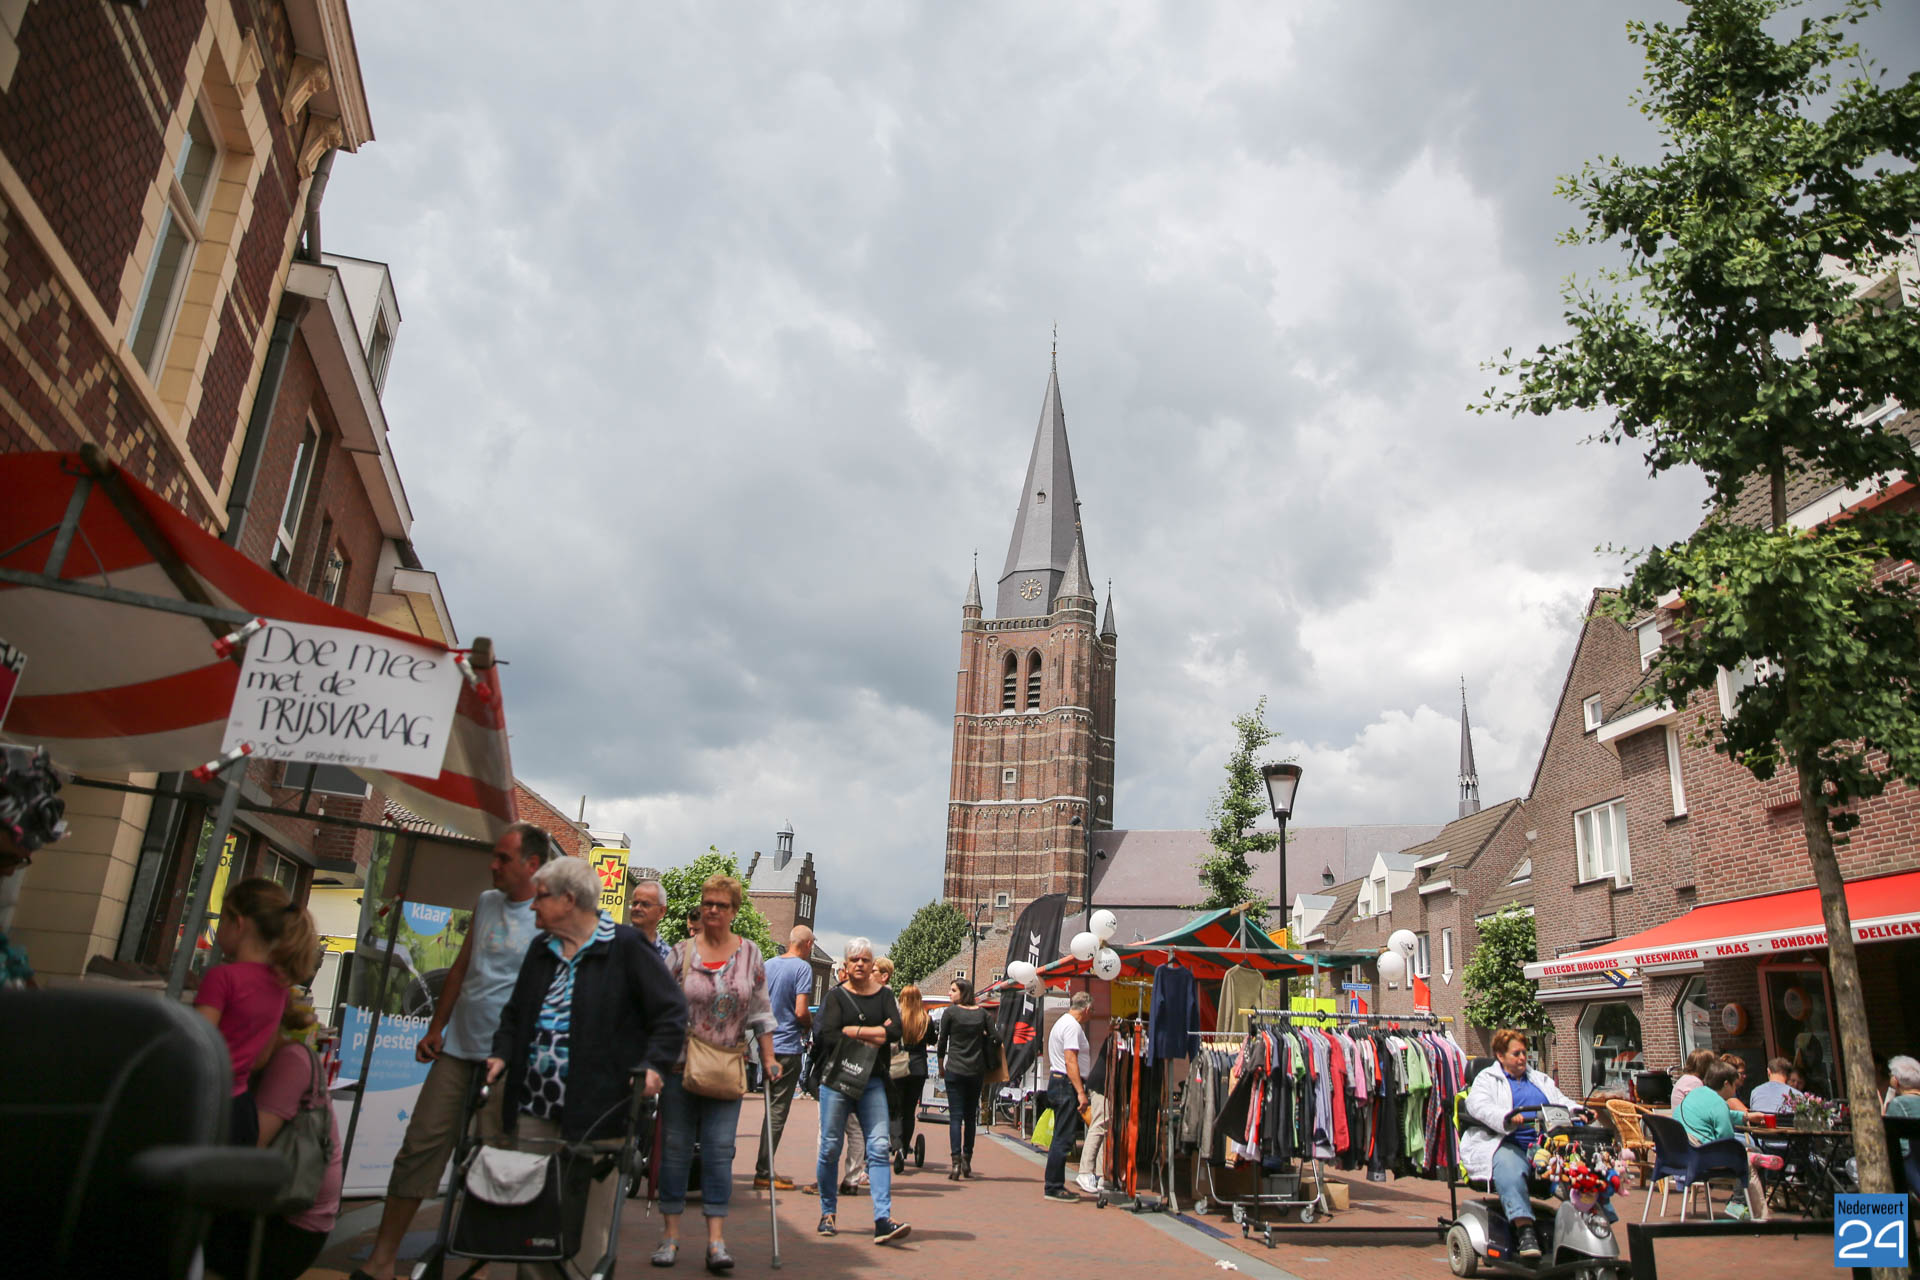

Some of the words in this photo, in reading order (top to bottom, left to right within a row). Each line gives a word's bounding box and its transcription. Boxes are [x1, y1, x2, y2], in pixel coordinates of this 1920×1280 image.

[255, 626, 337, 667] Doe
[348, 643, 437, 684] mee
[247, 670, 304, 693] met
[320, 670, 356, 697] de
[411, 903, 447, 923] klaar
[599, 894, 623, 906] HBO
[1543, 963, 1576, 976] BELEGDE
[1577, 958, 1619, 972] BROODJES
[1634, 949, 1699, 965] VLEESWAREN
[1716, 942, 1750, 955] KAAS
[352, 1028, 418, 1053] pipestel
